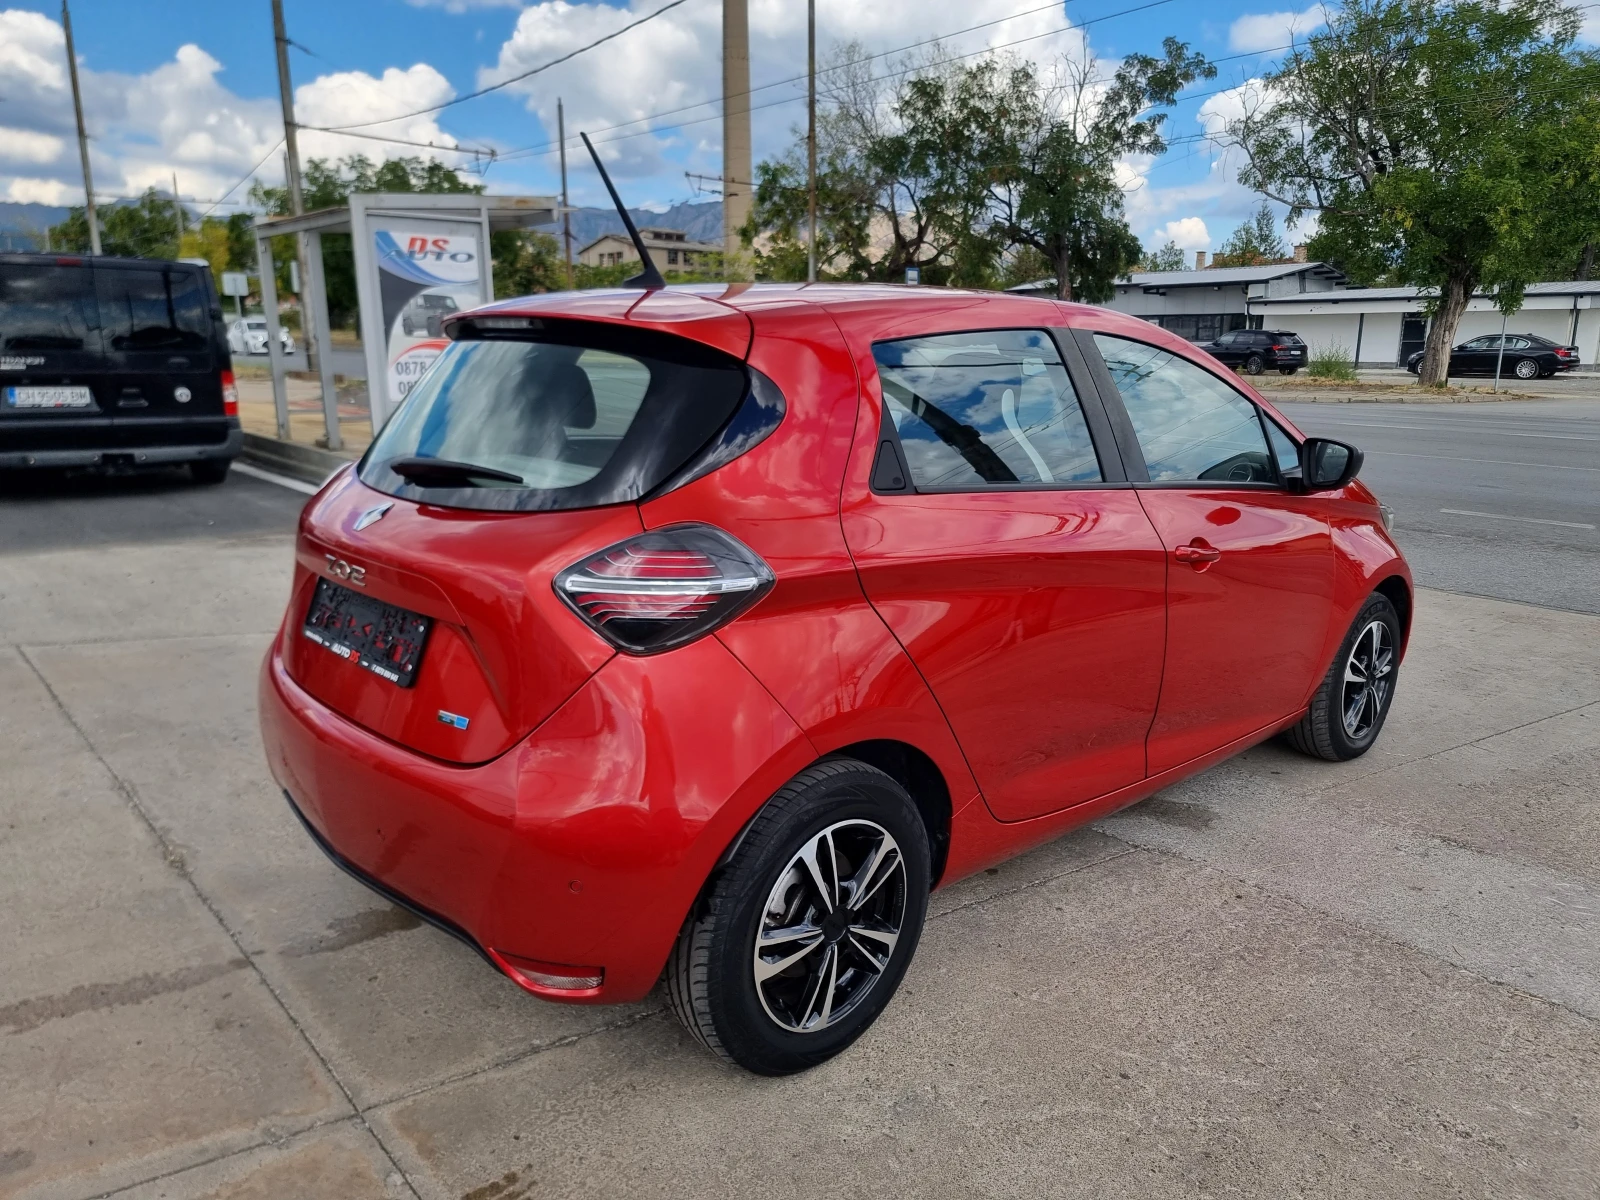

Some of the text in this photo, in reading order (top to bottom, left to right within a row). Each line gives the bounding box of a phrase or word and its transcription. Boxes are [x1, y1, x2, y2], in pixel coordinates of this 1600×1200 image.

[407, 237, 451, 253] DS
[381, 250, 475, 263] AUTO
[396, 361, 427, 375] 0878
[331, 643, 360, 664] AUTO DS
